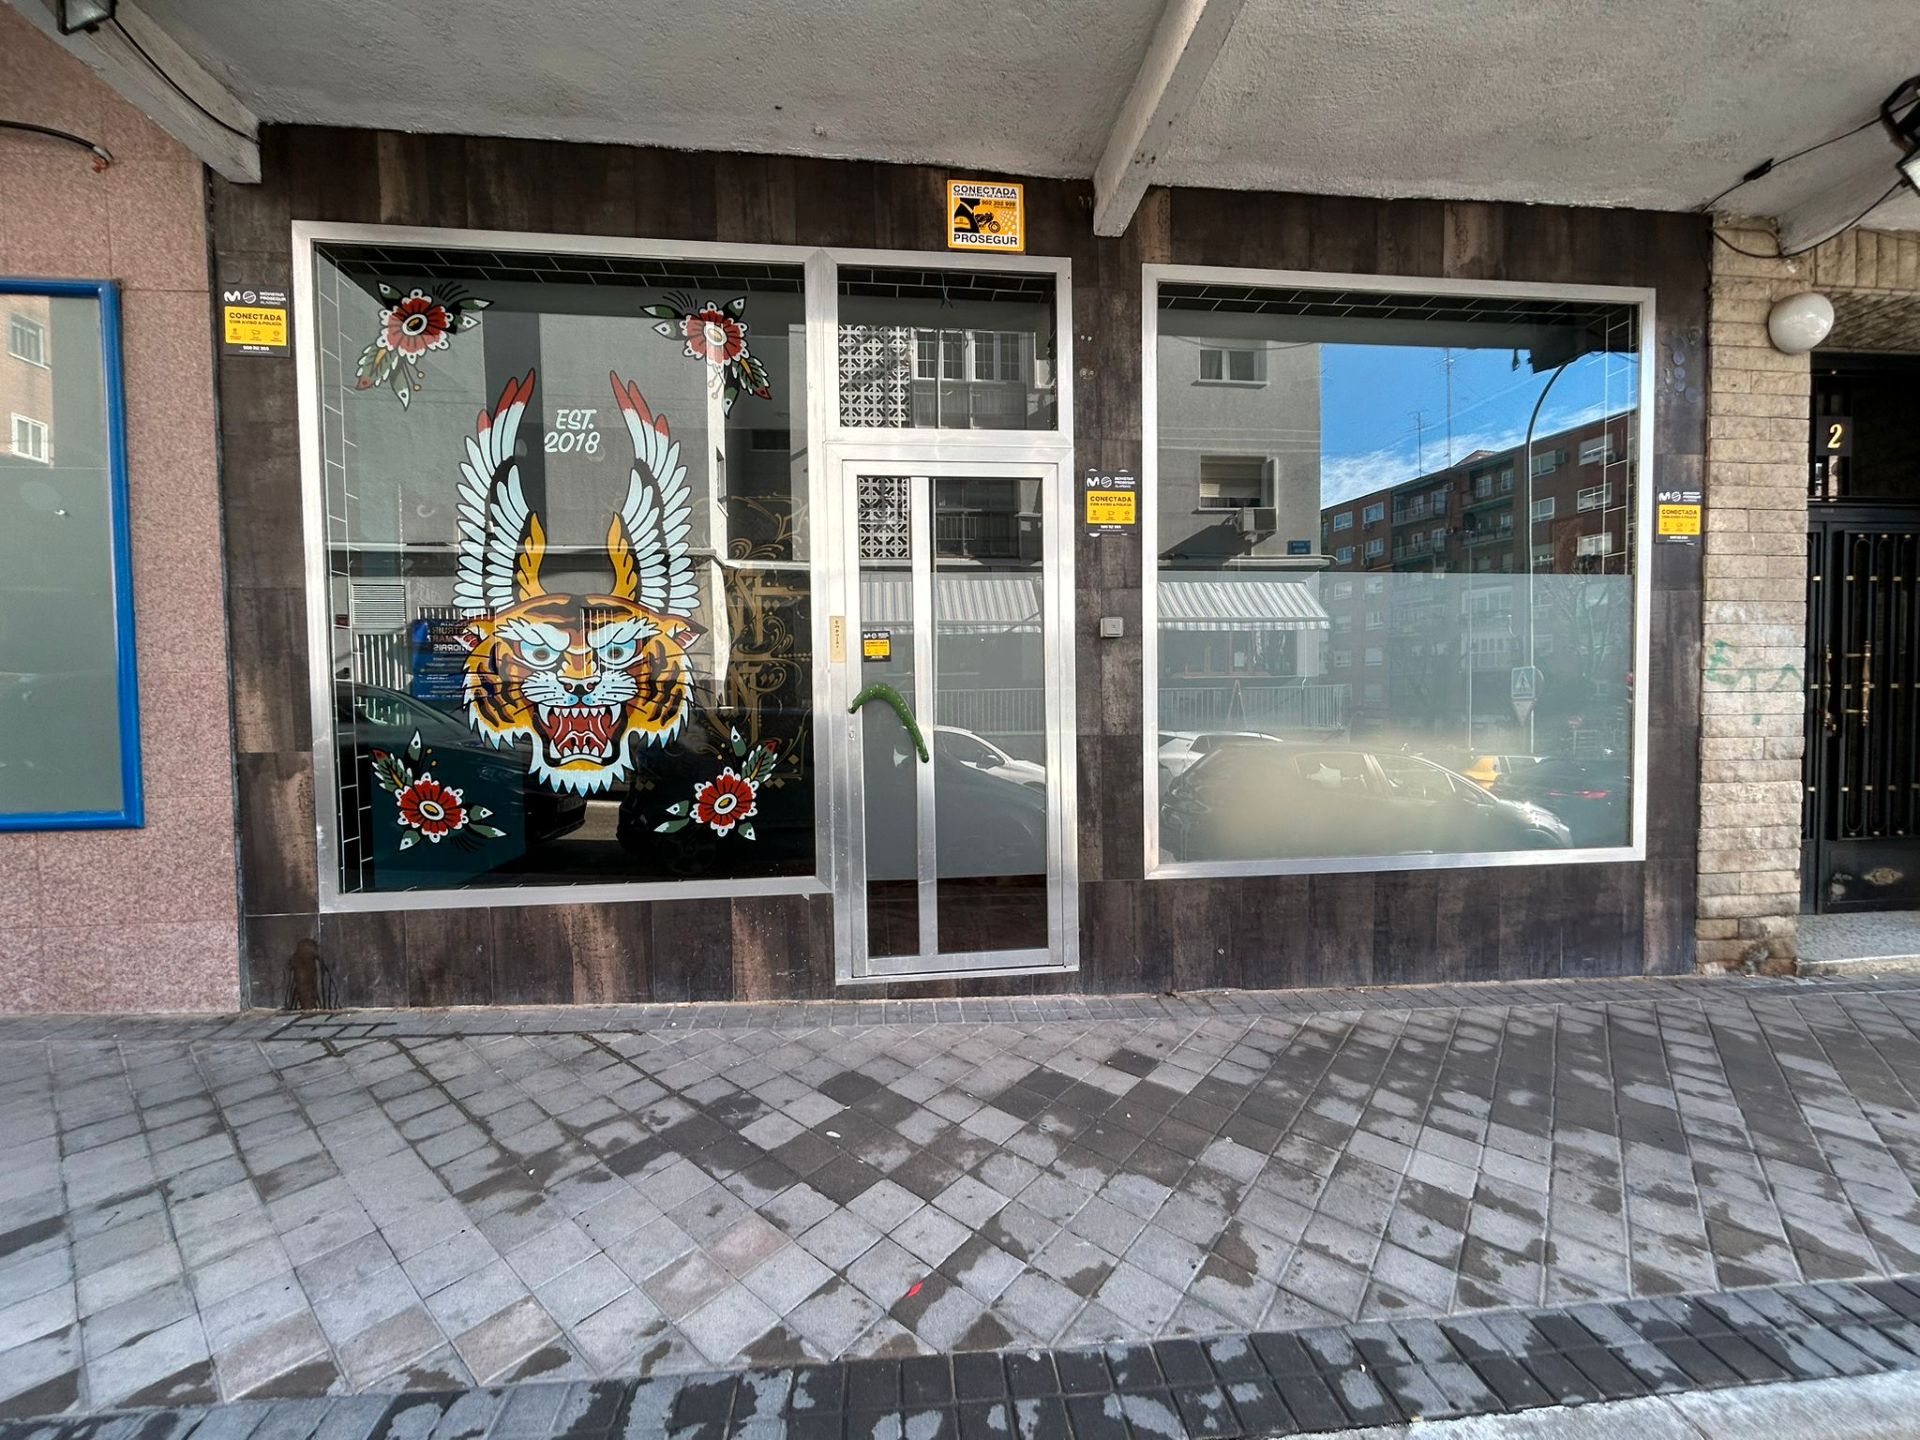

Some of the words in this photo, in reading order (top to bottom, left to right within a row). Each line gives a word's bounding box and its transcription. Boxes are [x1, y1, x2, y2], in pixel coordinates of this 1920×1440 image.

[953, 185, 1017, 196] CONECTADA
[953, 234, 1018, 245] PROSEGUR
[229, 312, 282, 321] CONECTADA
[556, 409, 598, 430] EST.
[544, 431, 600, 454] 2018
[1827, 423, 1843, 448] 2
